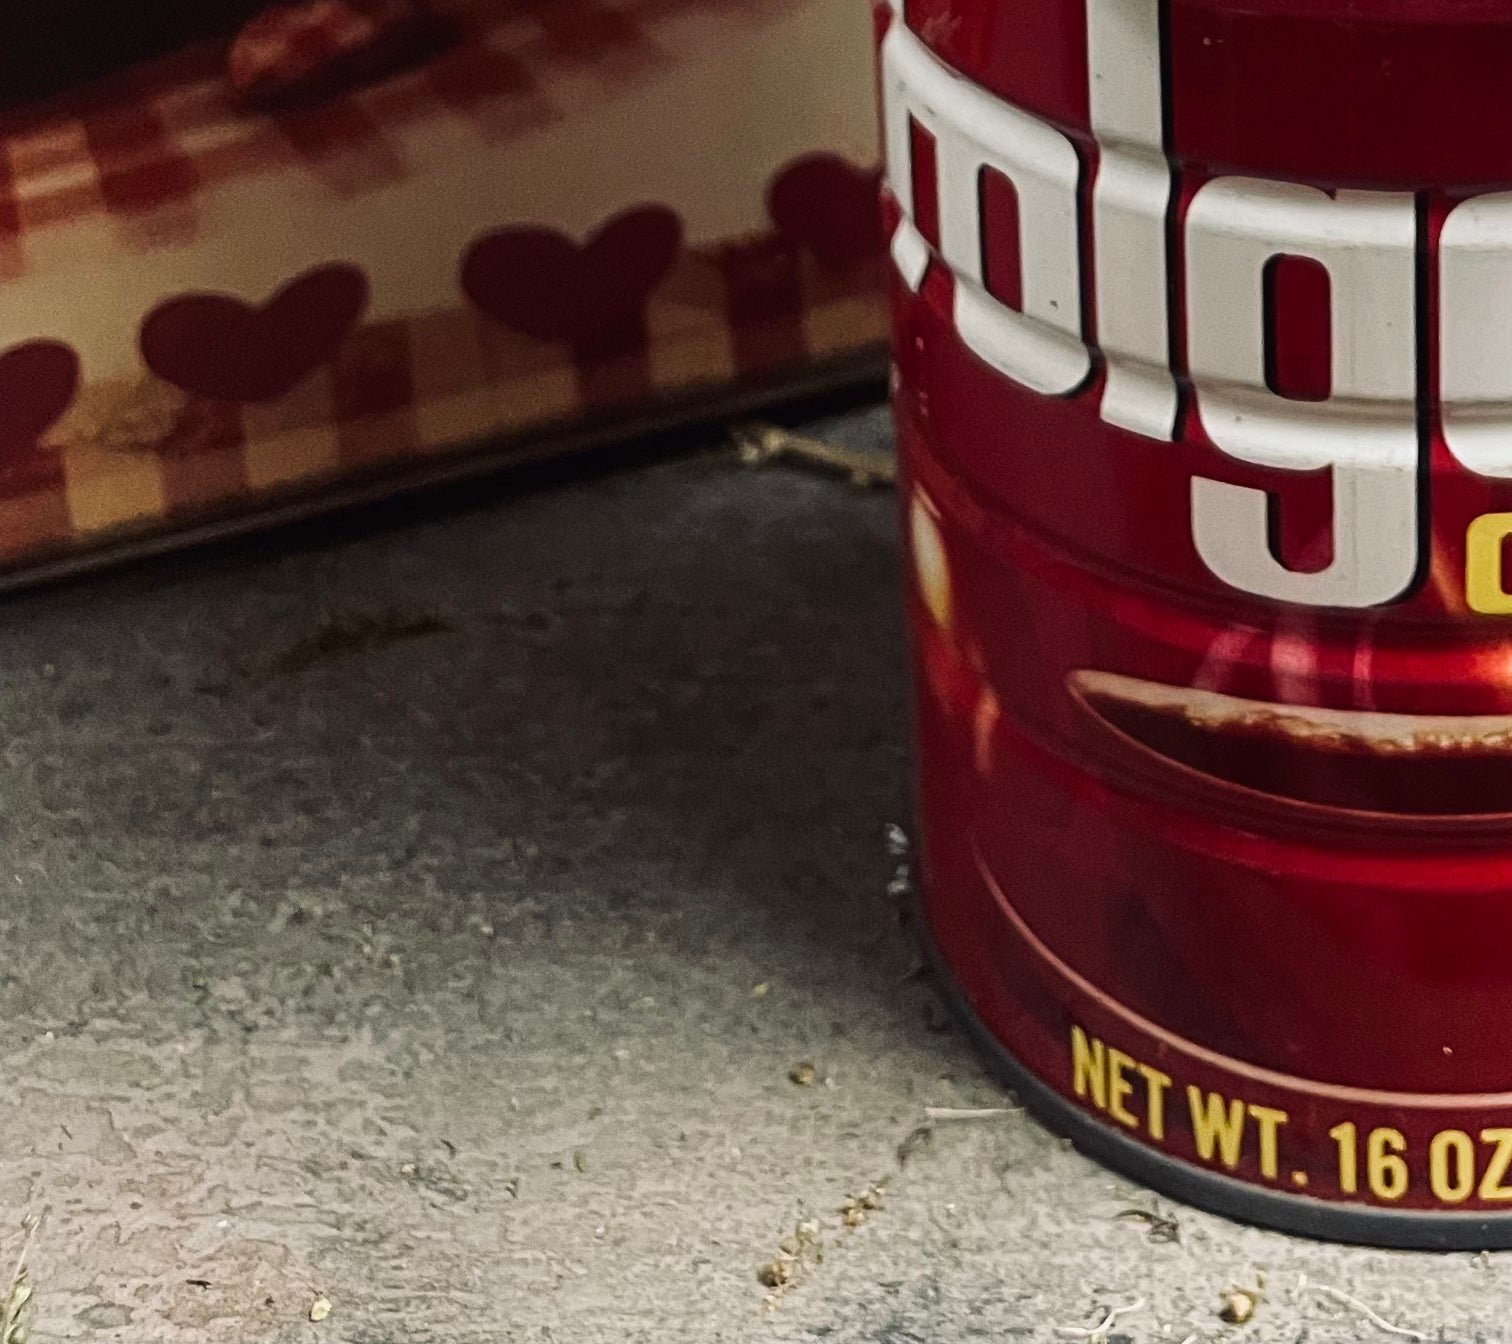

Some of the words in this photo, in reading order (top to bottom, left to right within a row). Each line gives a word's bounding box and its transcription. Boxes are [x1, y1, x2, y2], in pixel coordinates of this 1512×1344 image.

[1070, 1024, 1172, 1140] NET
[1188, 1082, 1309, 1188] WT.
[1329, 1120, 1409, 1201] 16
